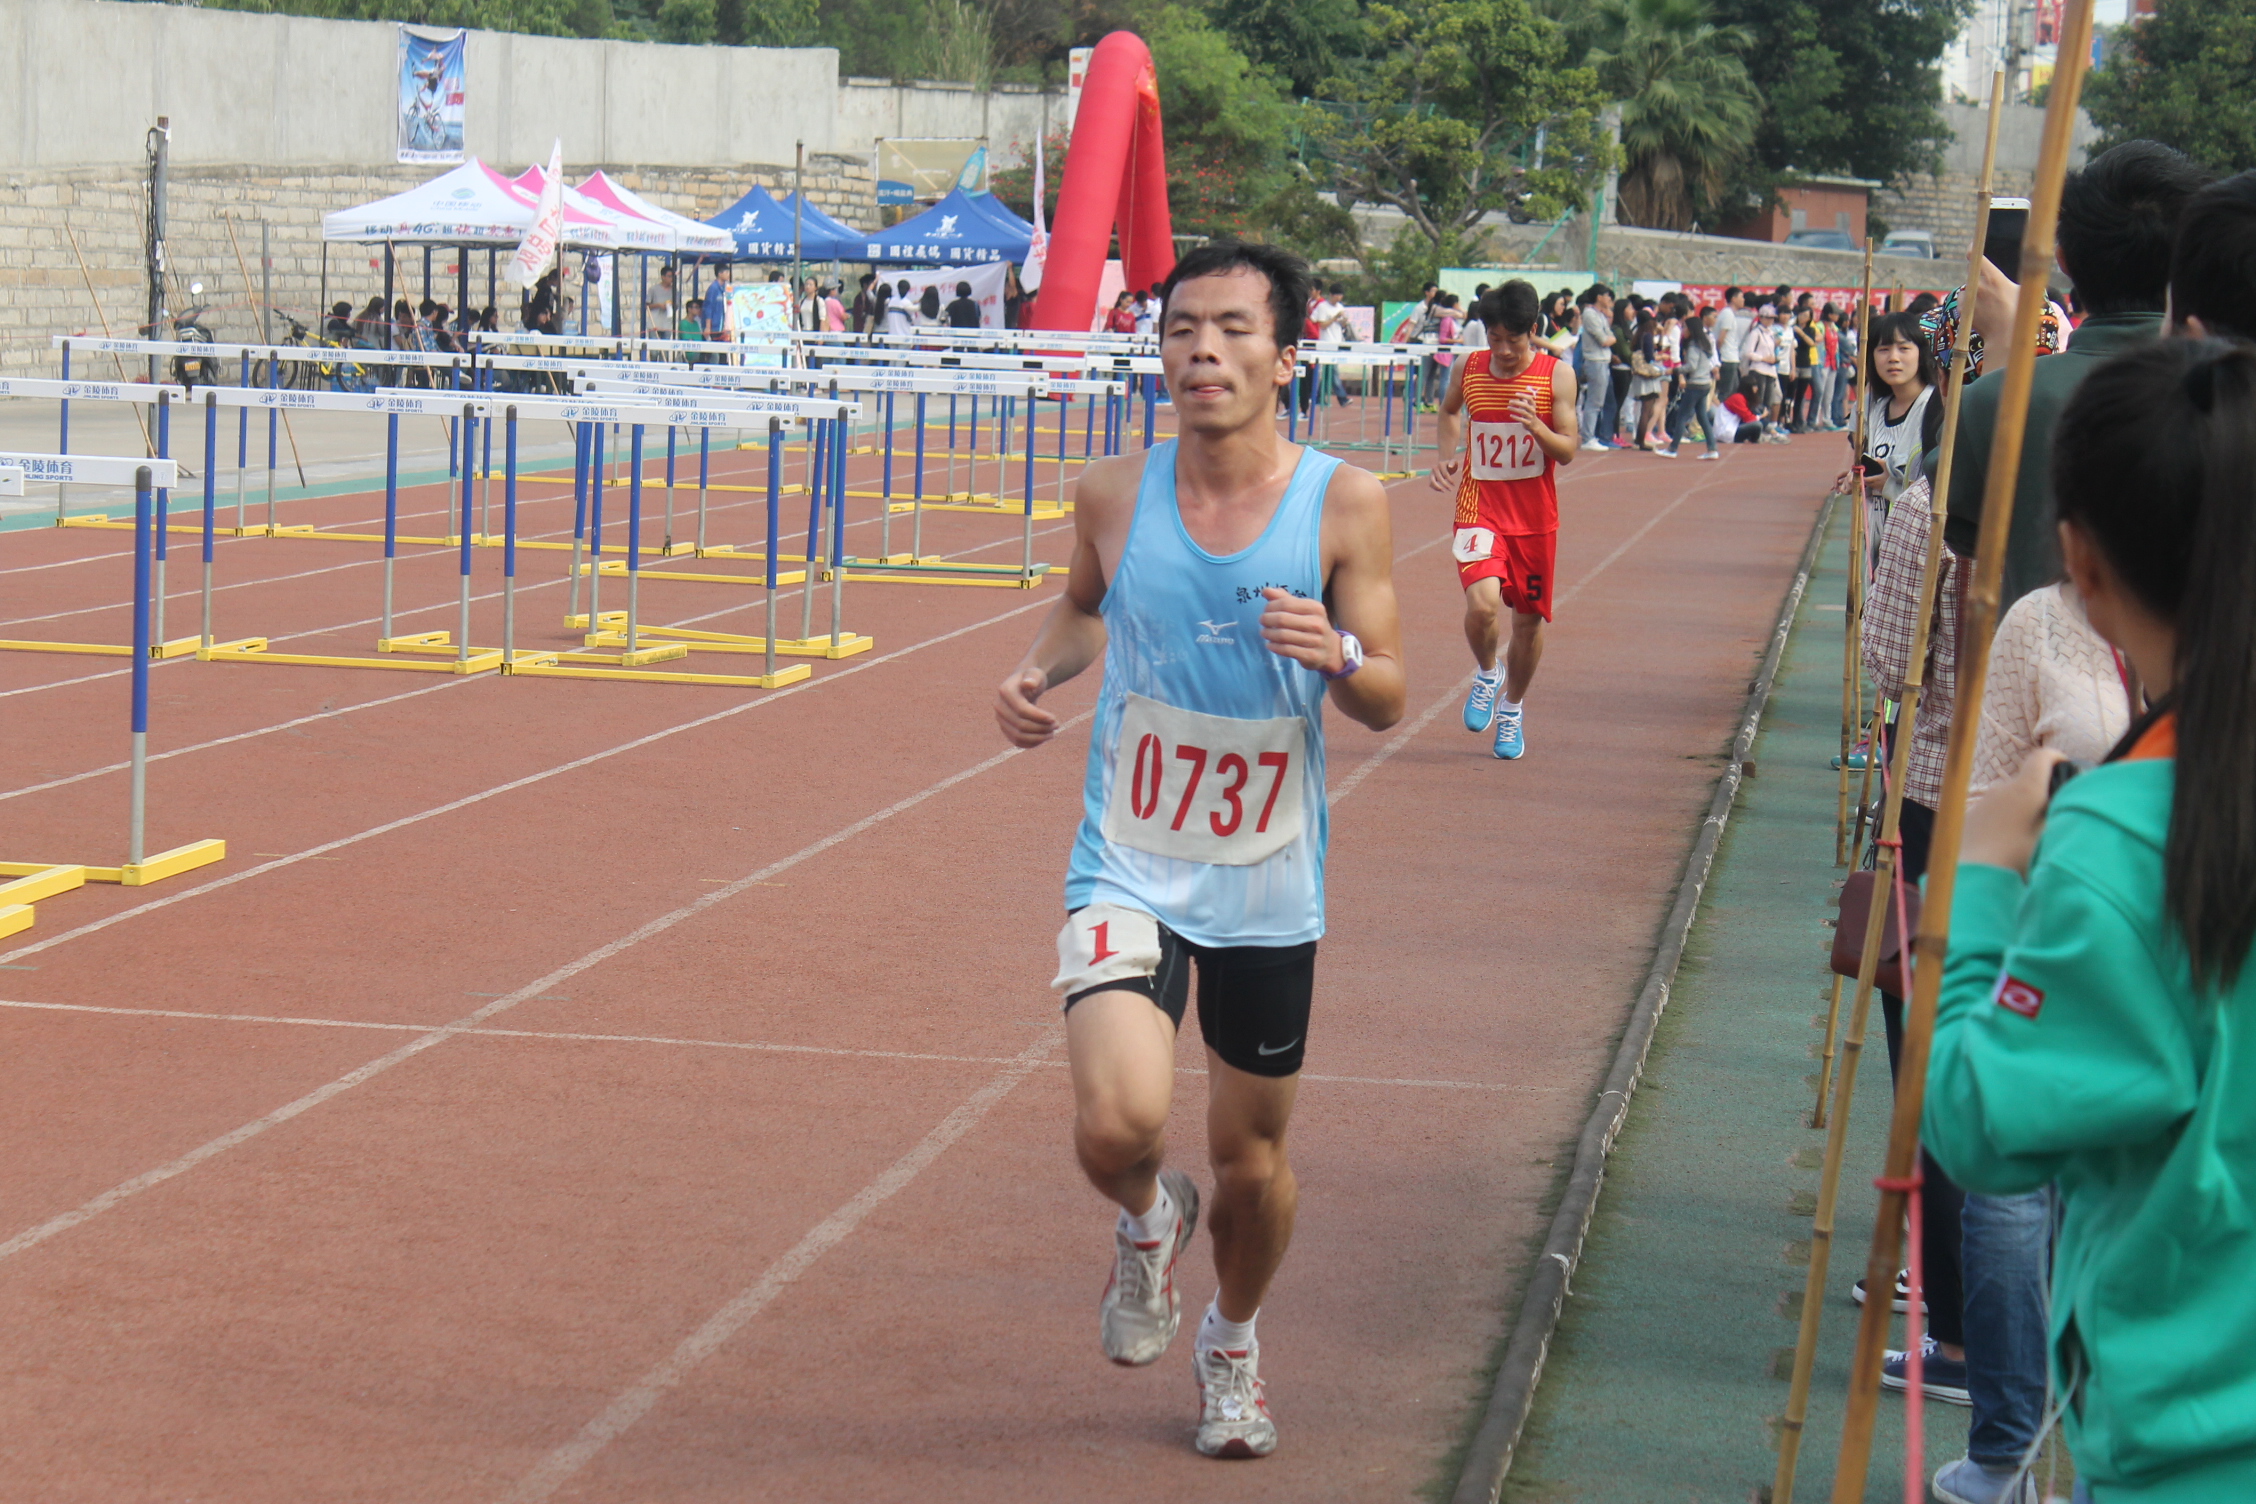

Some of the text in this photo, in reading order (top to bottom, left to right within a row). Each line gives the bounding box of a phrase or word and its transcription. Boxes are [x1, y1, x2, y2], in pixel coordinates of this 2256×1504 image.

[84, 385, 119, 395] 金陵体育
[280, 394, 315, 403] 金陵体育
[387, 399, 423, 408] 金陵体育
[582, 407, 617, 417] 金陵体育
[767, 403, 799, 411] 金陵体育
[691, 412, 726, 422] 金陵体育
[1476, 433, 1535, 468] 1212
[19, 459, 73, 474] 金陵体育
[1463, 534, 1478, 553] 4
[1526, 575, 1542, 601] 5
[1131, 733, 1288, 837] 0737
[1086, 920, 1120, 966] 1
